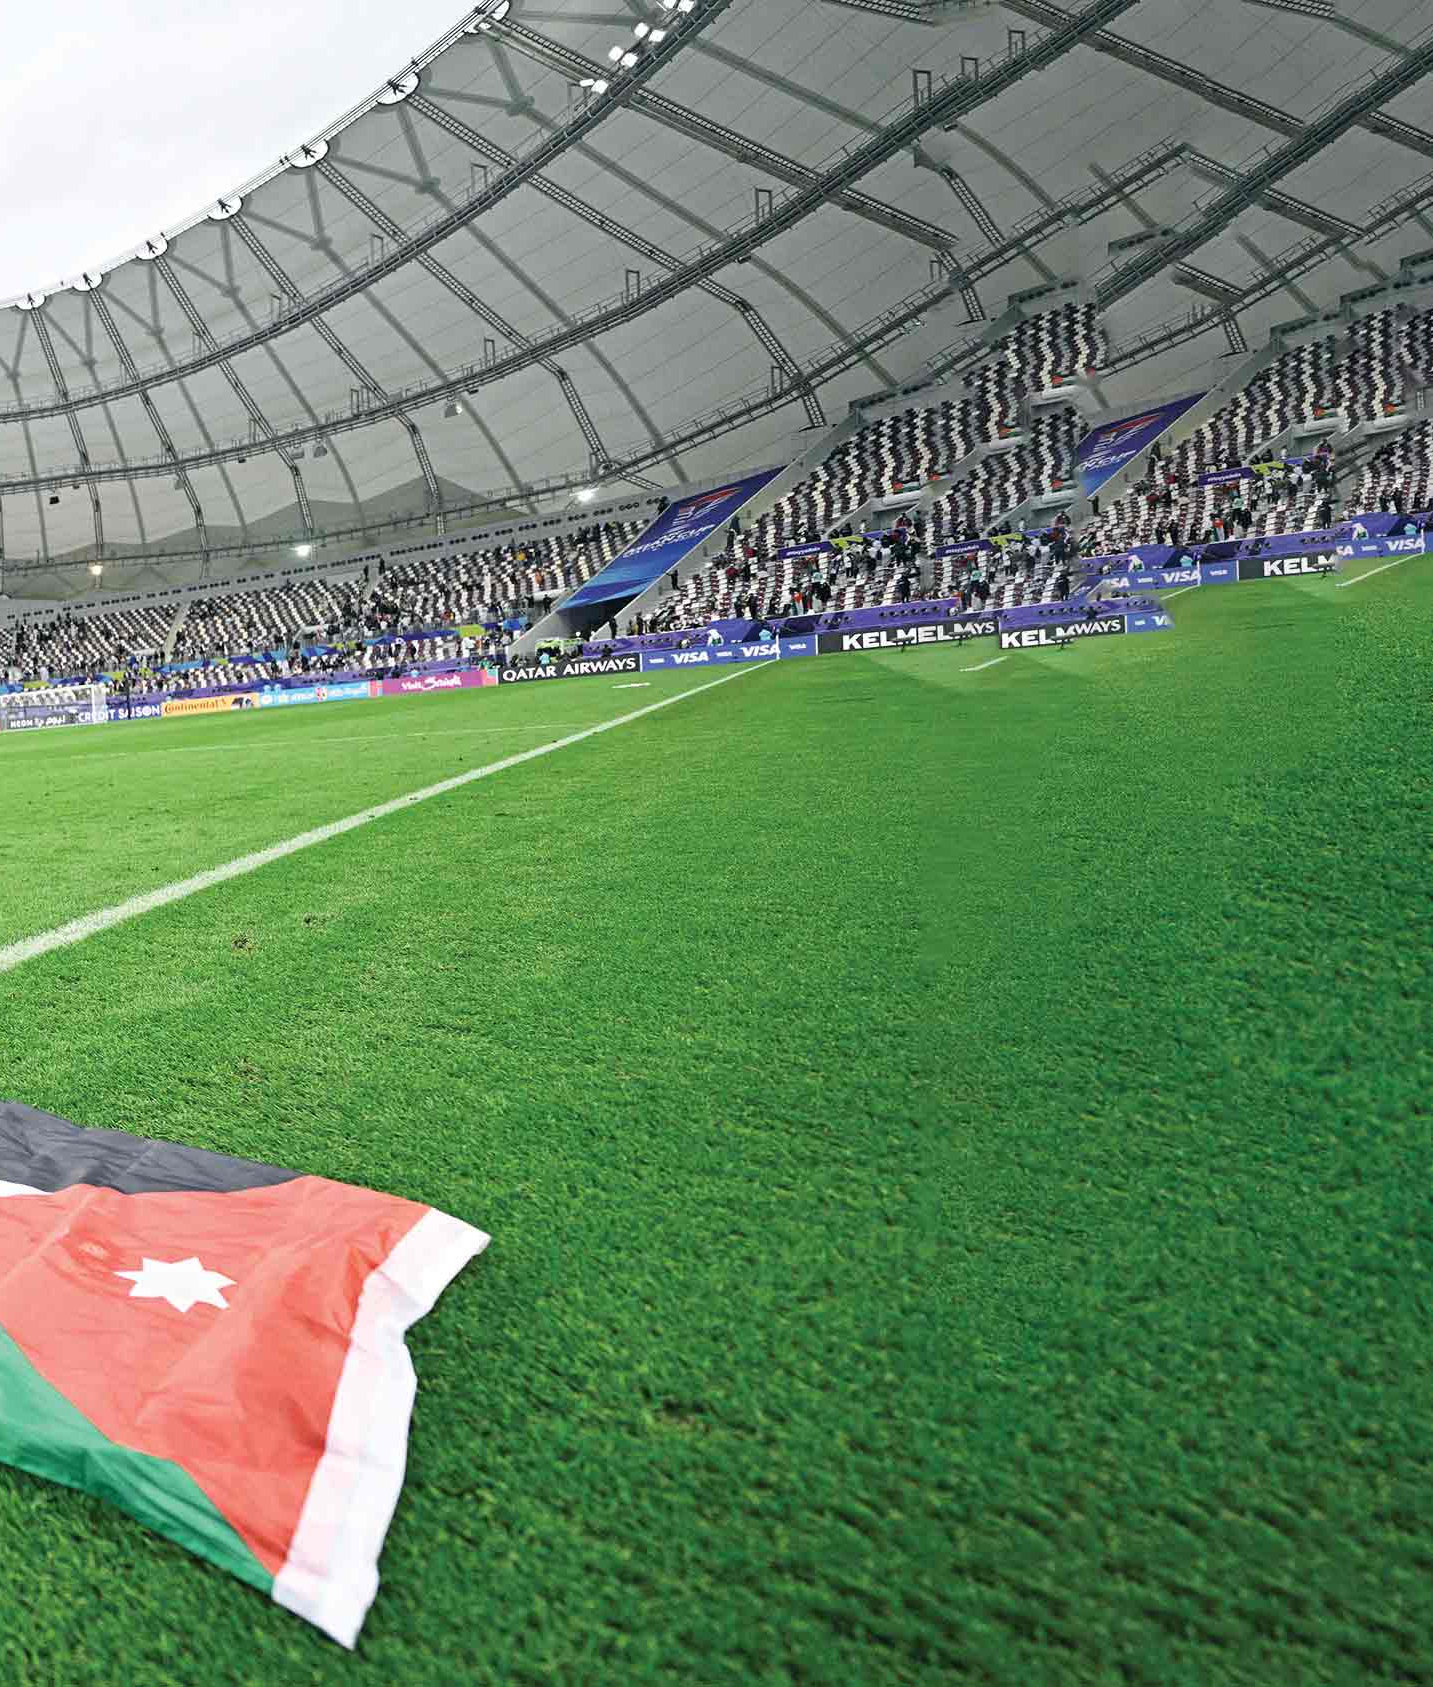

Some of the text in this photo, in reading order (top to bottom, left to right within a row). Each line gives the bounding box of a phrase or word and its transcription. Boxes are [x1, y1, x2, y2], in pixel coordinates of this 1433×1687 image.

[1385, 538, 1424, 551] VISA
[1161, 570, 1201, 584] VISA
[670, 651, 710, 664] VISA
[739, 644, 781, 657] VISA
[502, 657, 637, 682] QATAR AIRWAYS
[164, 699, 220, 714] Continental
